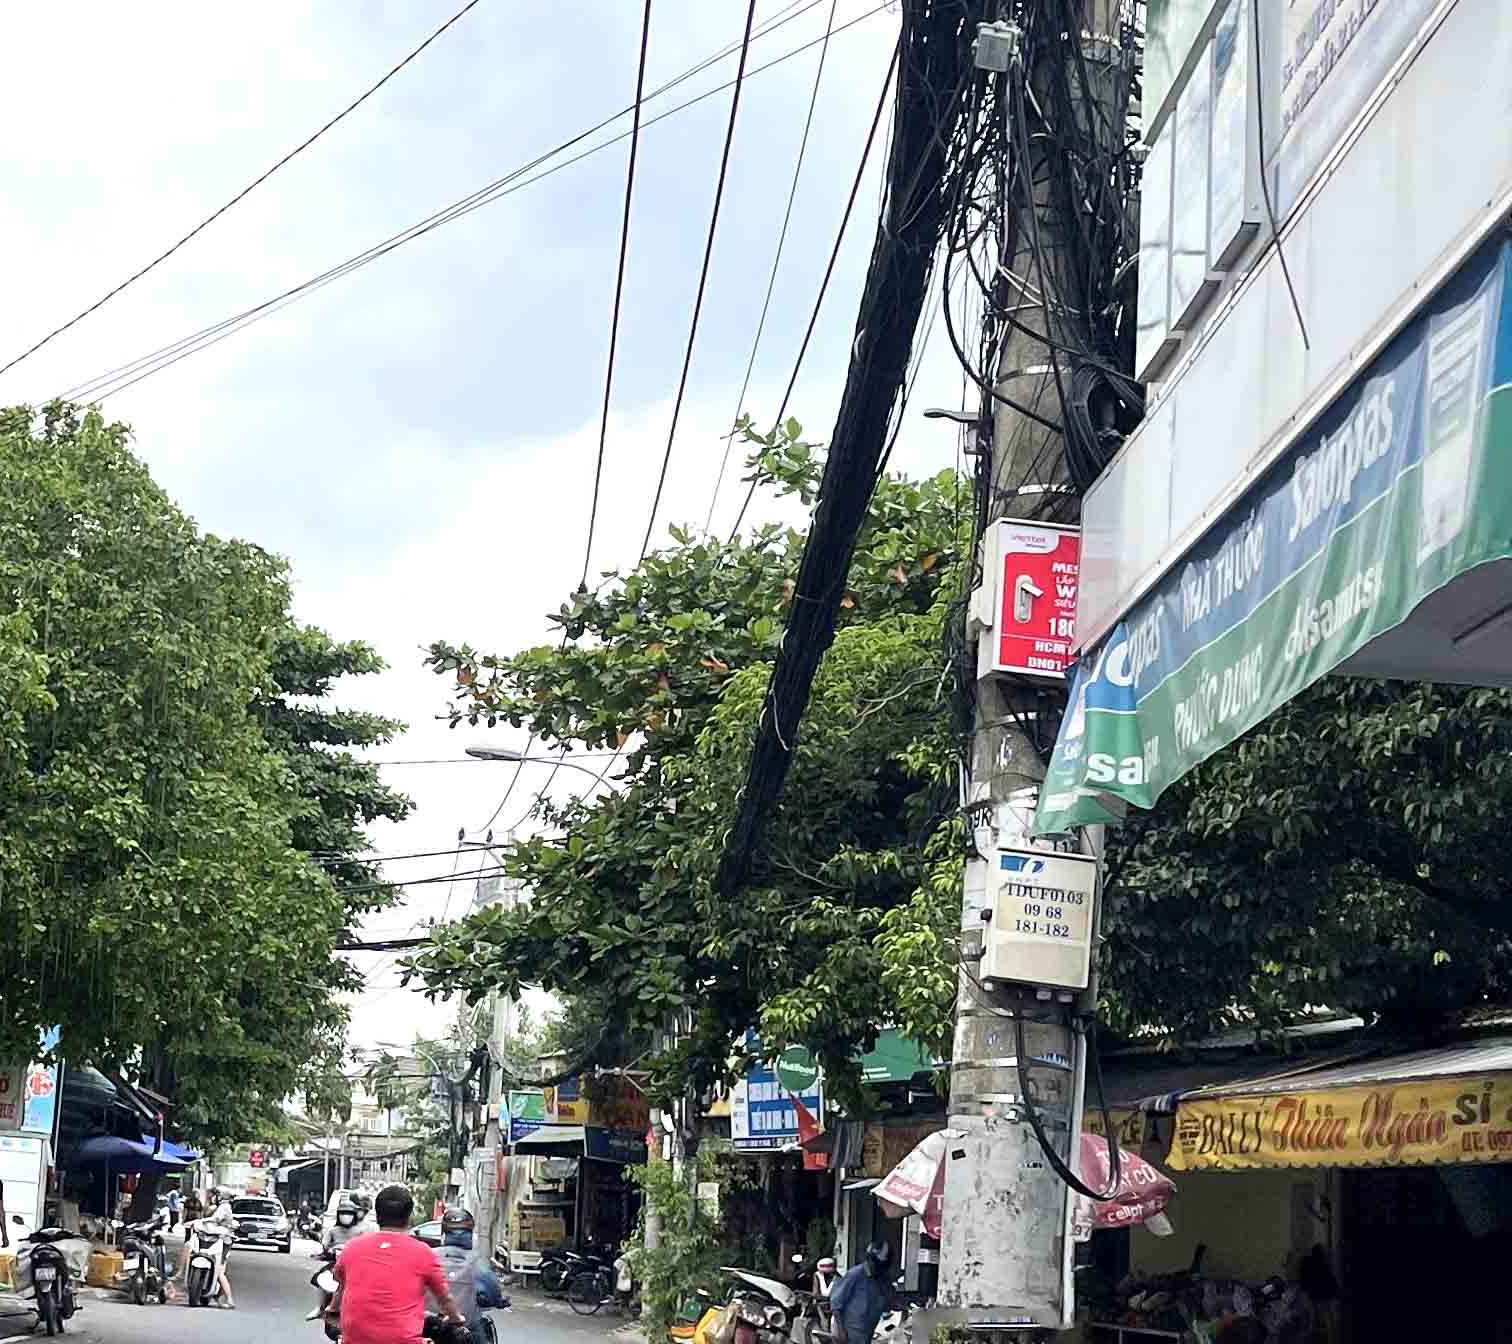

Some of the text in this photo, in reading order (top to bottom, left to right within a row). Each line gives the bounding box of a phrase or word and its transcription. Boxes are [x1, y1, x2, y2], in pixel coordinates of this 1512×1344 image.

[1023, 904, 1063, 920] 09 68
[1015, 919, 1070, 938] 181-182
